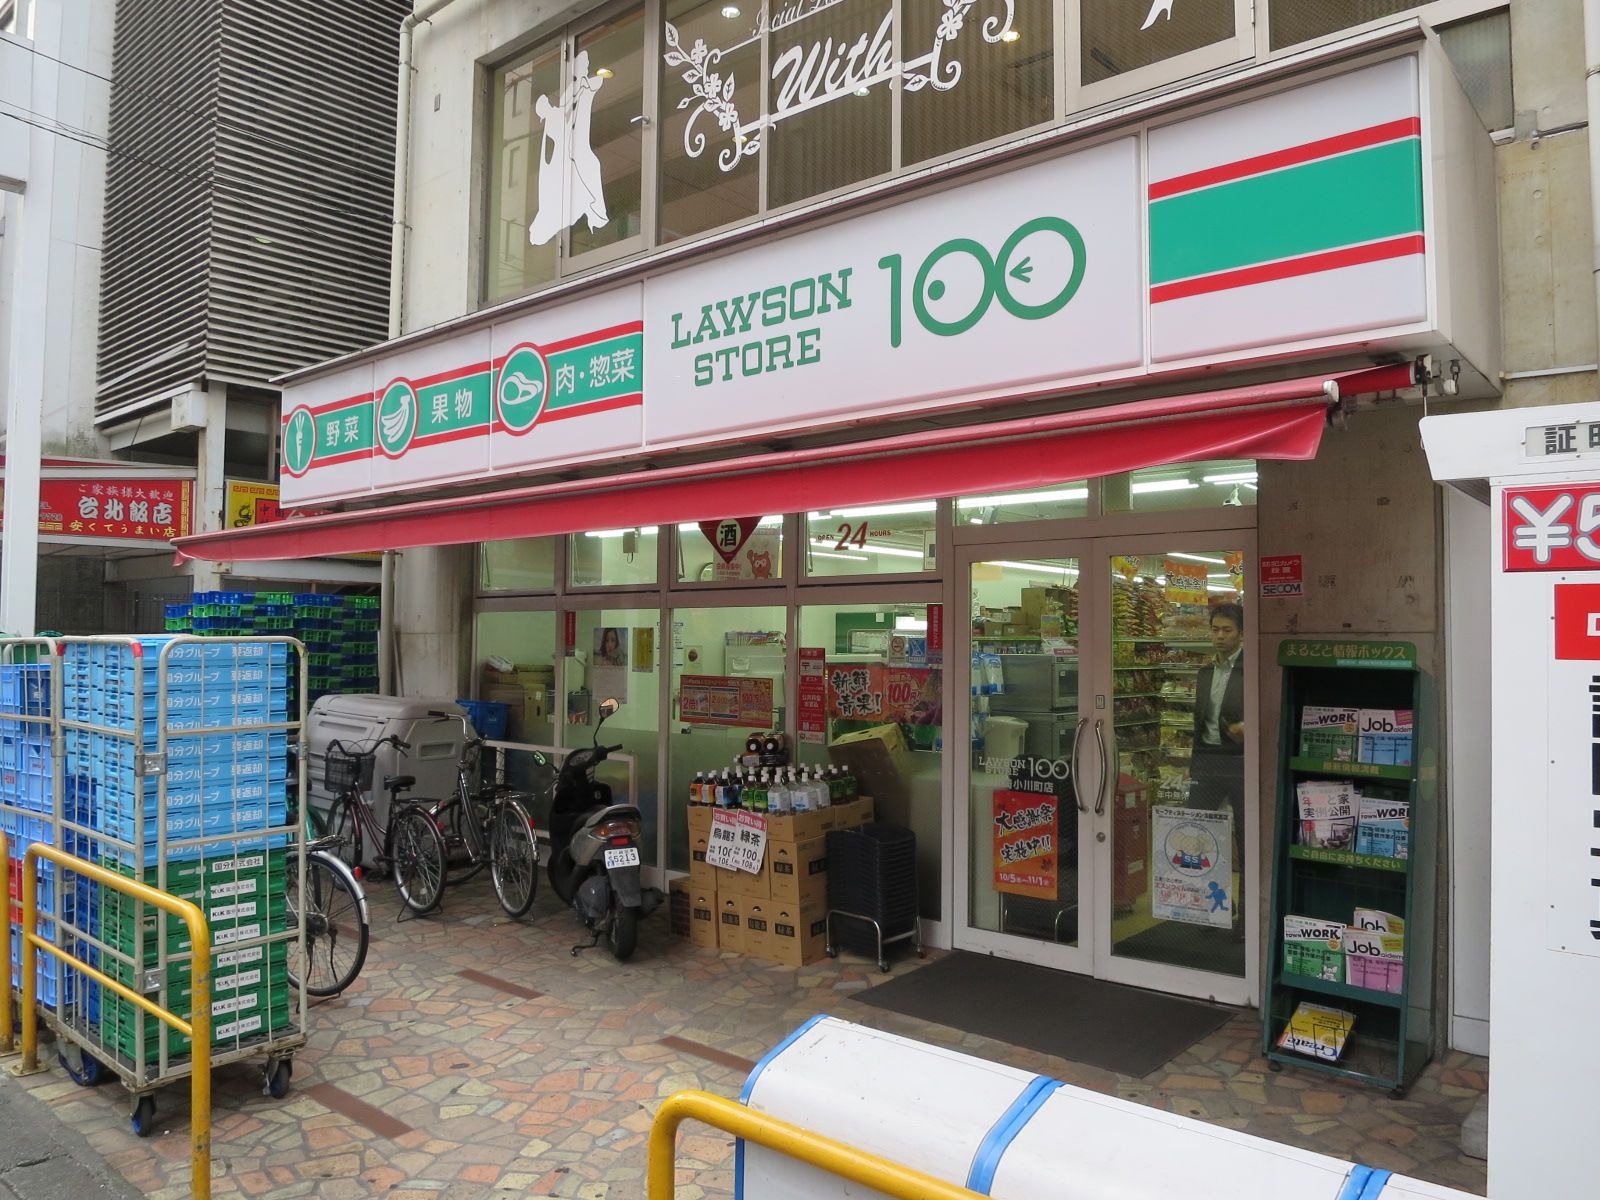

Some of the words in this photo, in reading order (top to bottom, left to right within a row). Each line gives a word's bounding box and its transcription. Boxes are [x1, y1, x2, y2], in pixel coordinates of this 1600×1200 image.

[771, 12, 897, 113] With
[671, 267, 853, 349] LAWSON
[877, 216, 1087, 348] 100
[694, 327, 822, 387] STORE
[555, 347, 636, 397] 肉・惣菜
[431, 388, 474, 424] 果物
[326, 416, 360, 447] 野菜
[78, 483, 174, 501] ご家族様大歓迎
[78, 496, 173, 525] 台北飯店
[69, 520, 177, 537] 安くてうまい店
[719, 523, 737, 547] 酒
[834, 521, 868, 551] 24
[869, 529, 892, 537] HOURS
[1263, 583, 1301, 595] SECOM
[1286, 643, 1406, 659] まるごと情報ボックス
[832, 669, 870, 694] 新鮮
[838, 693, 882, 717] 青果!
[1319, 713, 1356, 725] WORK
[1362, 717, 1393, 733] Job
[978, 756, 1026, 769] LAWSON
[1028, 757, 1069, 779] 100
[1008, 778, 1054, 794] 小川町店
[996, 803, 1055, 835] 大感謝祭
[740, 829, 761, 847] 緑茶
[613, 853, 636, 863] 5213
[742, 847, 757, 861] 100
[1183, 855, 1199, 863] SS
[1302, 850, 1401, 868] ご自由にお持ちください
[1301, 928, 1340, 940] WORK
[1348, 940, 1380, 956] Job
[1288, 1037, 1337, 1057] Create
